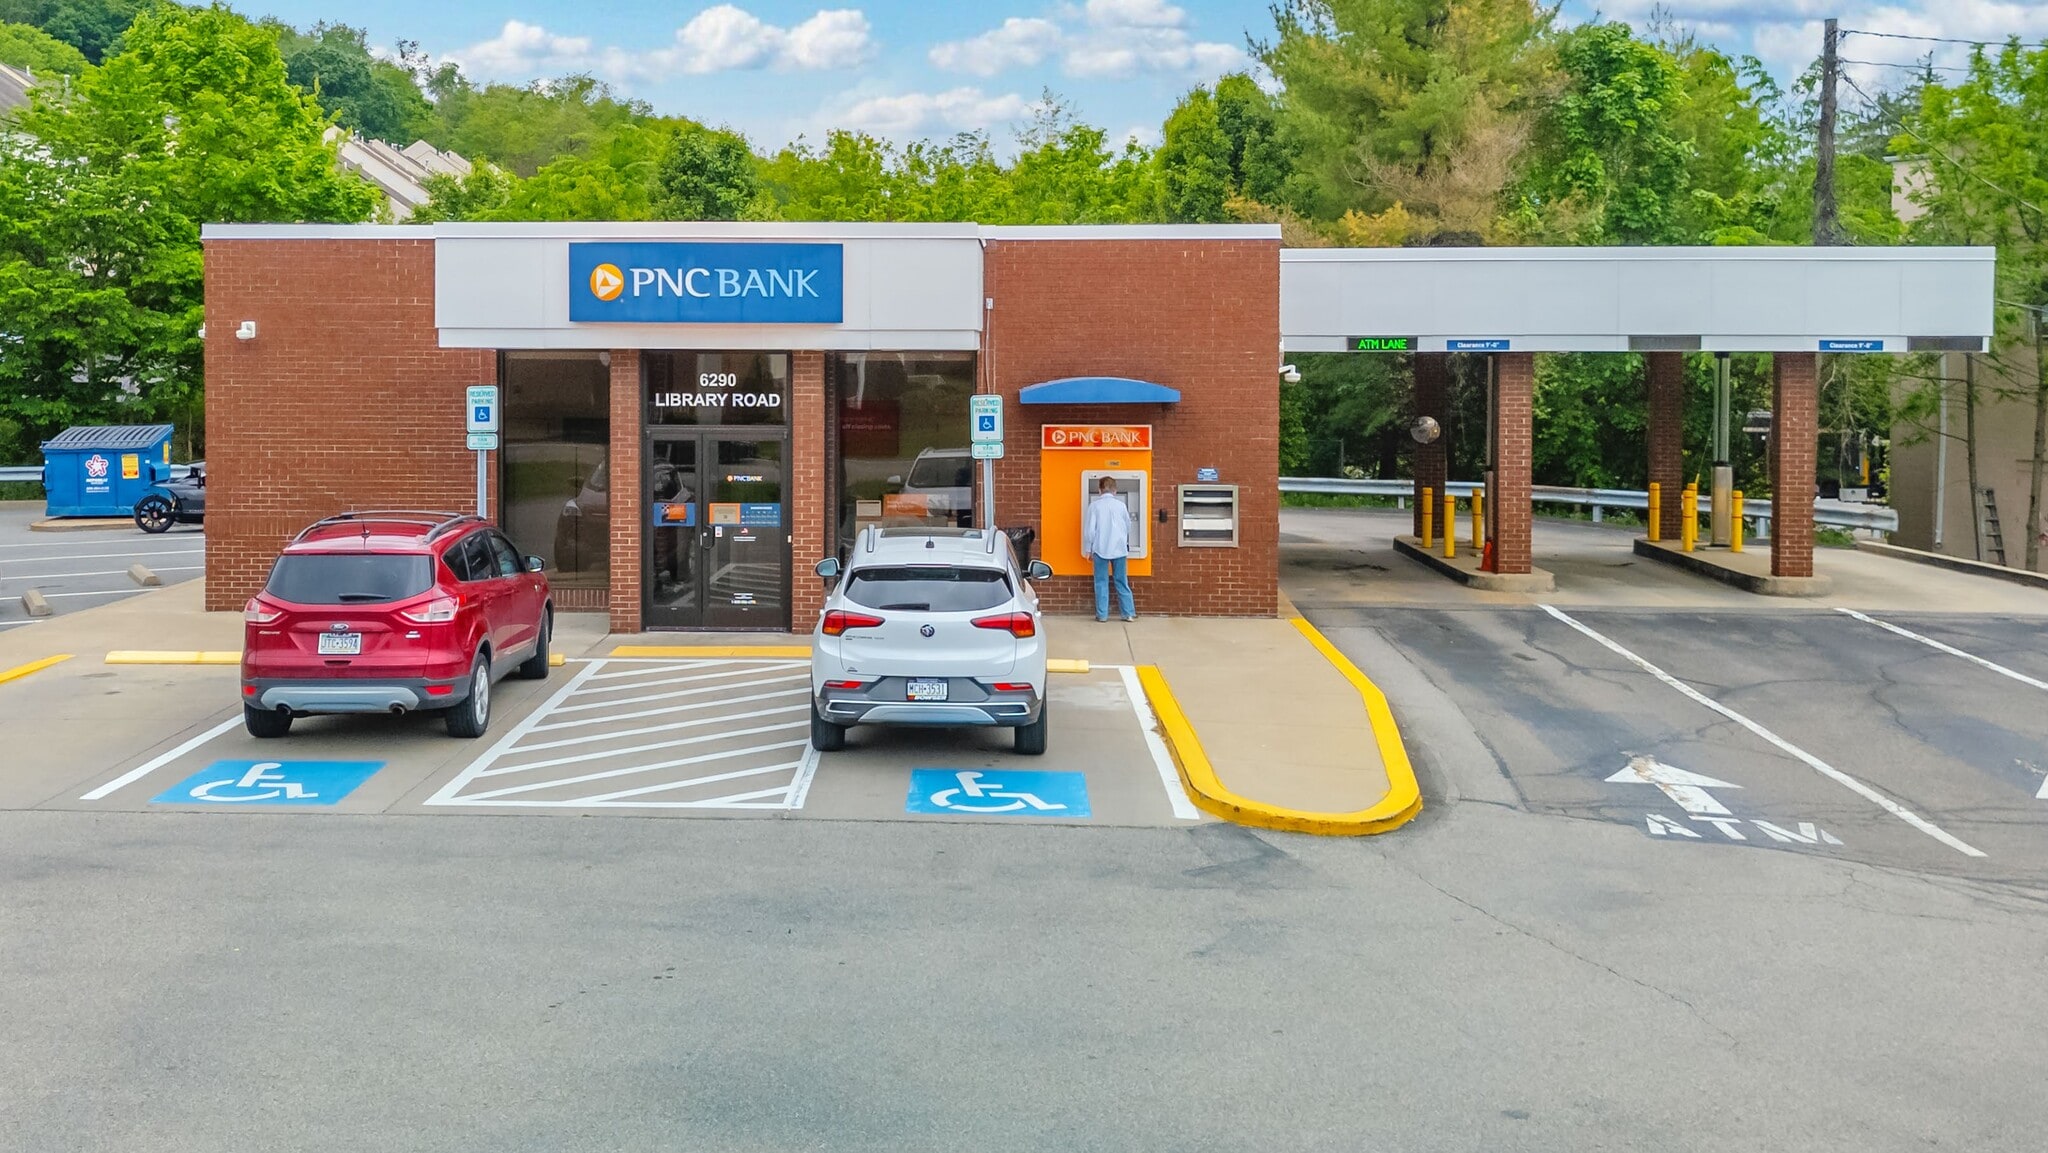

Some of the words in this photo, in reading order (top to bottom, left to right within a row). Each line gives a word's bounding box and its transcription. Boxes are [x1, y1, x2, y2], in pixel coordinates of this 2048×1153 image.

[629, 267, 710, 298] PNC
[714, 268, 820, 298] BANK
[1358, 339, 1379, 350] ATM
[1381, 339, 1408, 350] LANE
[1457, 341, 1485, 349] Clearance
[700, 373, 737, 387] 6290
[655, 393, 729, 407] LIBRARY
[732, 393, 781, 407] ROAD
[1069, 431, 1100, 444] PNC
[1101, 431, 1140, 444] BANK
